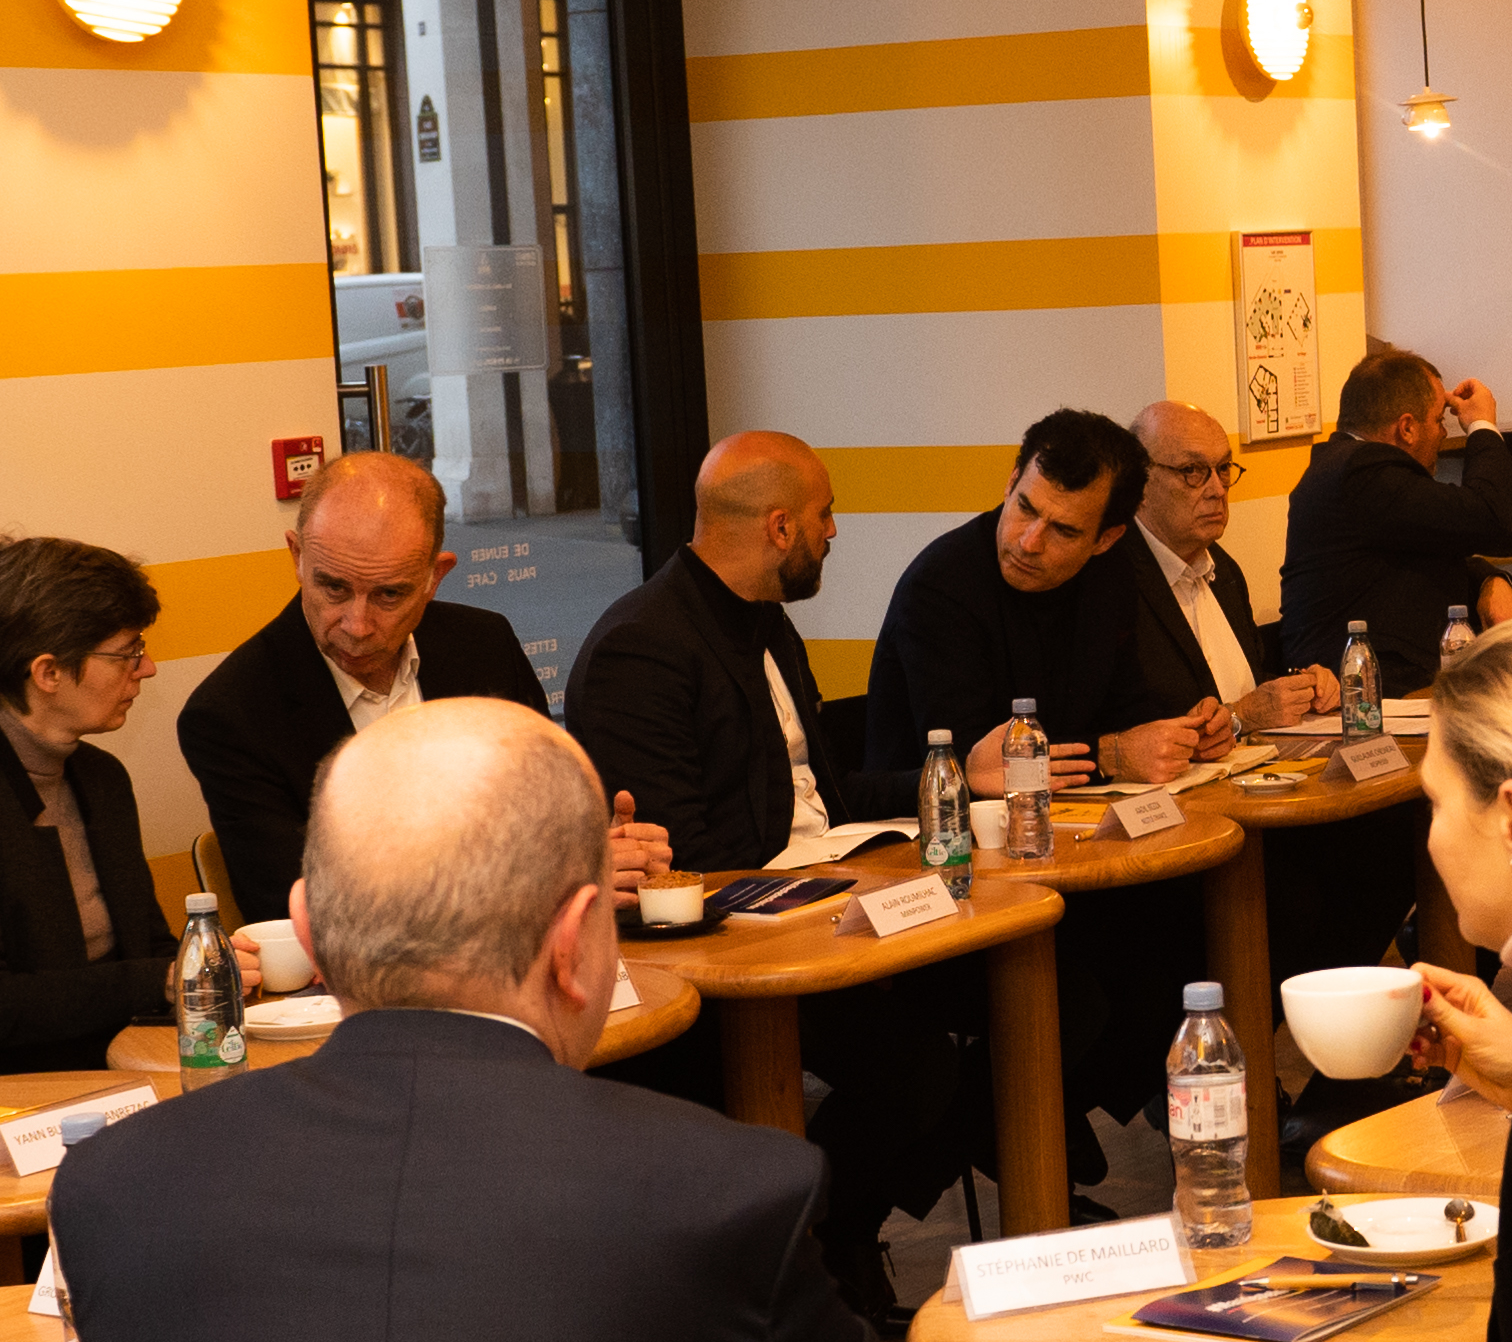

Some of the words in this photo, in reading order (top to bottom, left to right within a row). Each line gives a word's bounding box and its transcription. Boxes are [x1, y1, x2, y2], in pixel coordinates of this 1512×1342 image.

[14, 1130, 47, 1146] YANN
[977, 1253, 1063, 1277] STÉPHANIE
[1067, 1250, 1088, 1265] DE
[1091, 1238, 1170, 1261] MAILLARD
[1063, 1271, 1094, 1285] PWC
